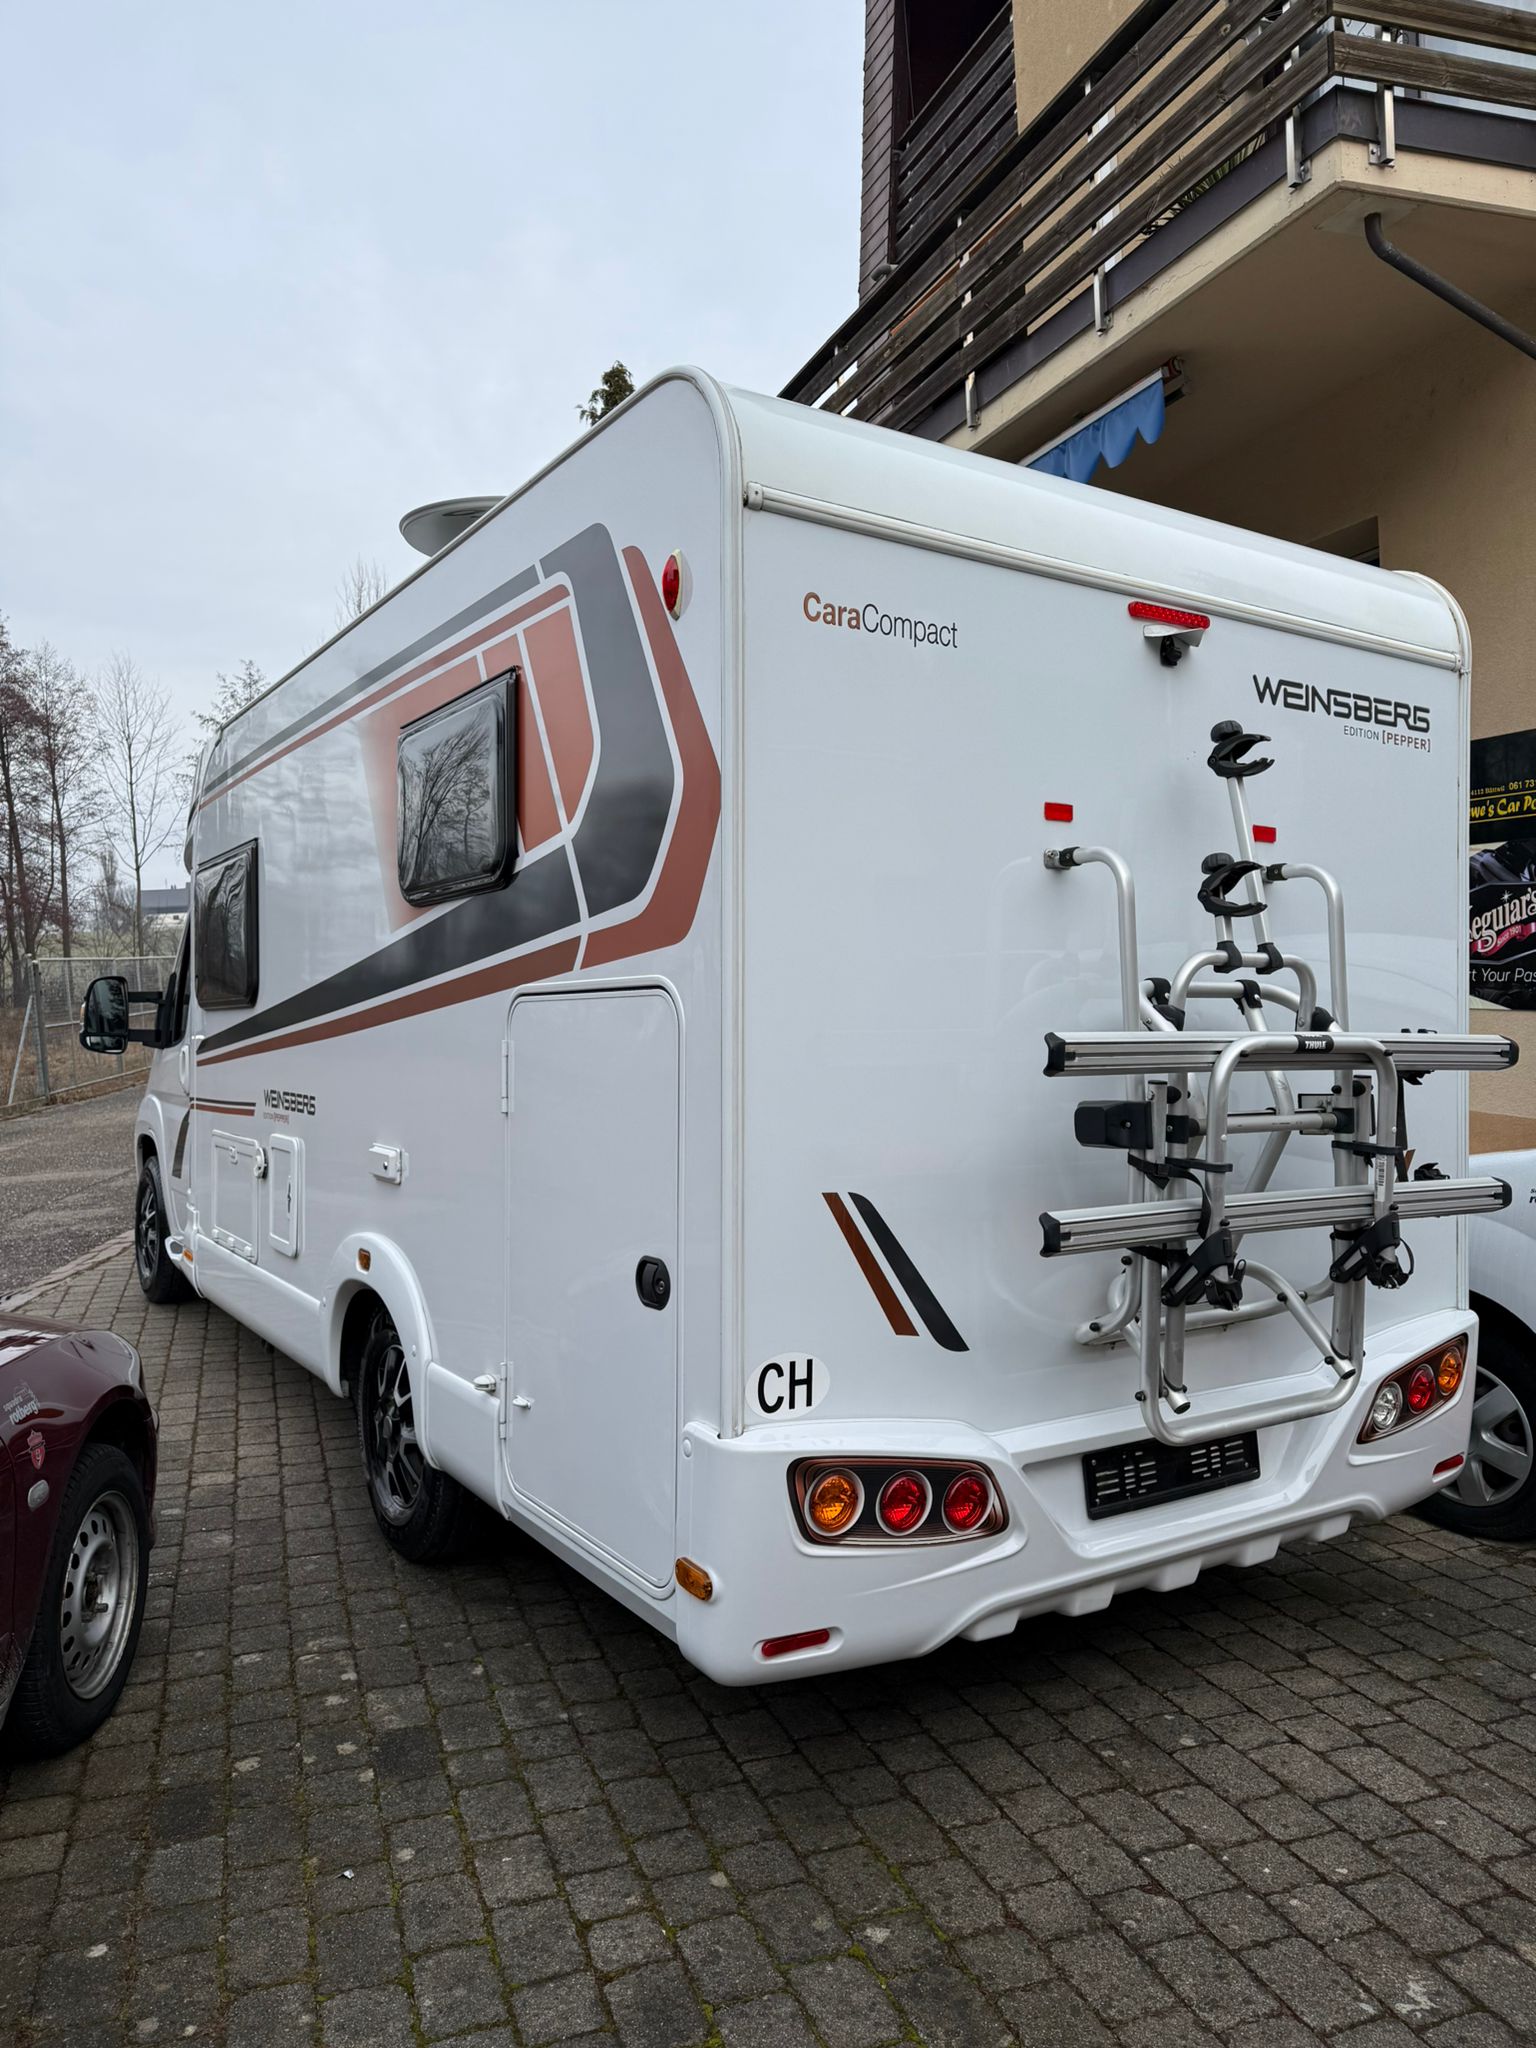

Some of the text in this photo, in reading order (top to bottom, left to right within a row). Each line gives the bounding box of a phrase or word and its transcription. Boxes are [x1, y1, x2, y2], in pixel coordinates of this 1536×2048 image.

[803, 592, 958, 649] CaraCompact
[1253, 674, 1430, 733] WEINSBERG
[1344, 725, 1431, 752] EDITION [PEPPER]
[1508, 781, 1522, 790] 061
[1524, 779, 1536, 788] 73
[1470, 799, 1495, 818] we's
[1497, 798, 1521, 815] Car
[1469, 887, 1536, 953] eguiar's
[1481, 967, 1511, 982] Your
[1304, 1040, 1327, 1050] THULE
[263, 1089, 316, 1116] WEINSBERG
[758, 1359, 813, 1414] CH
